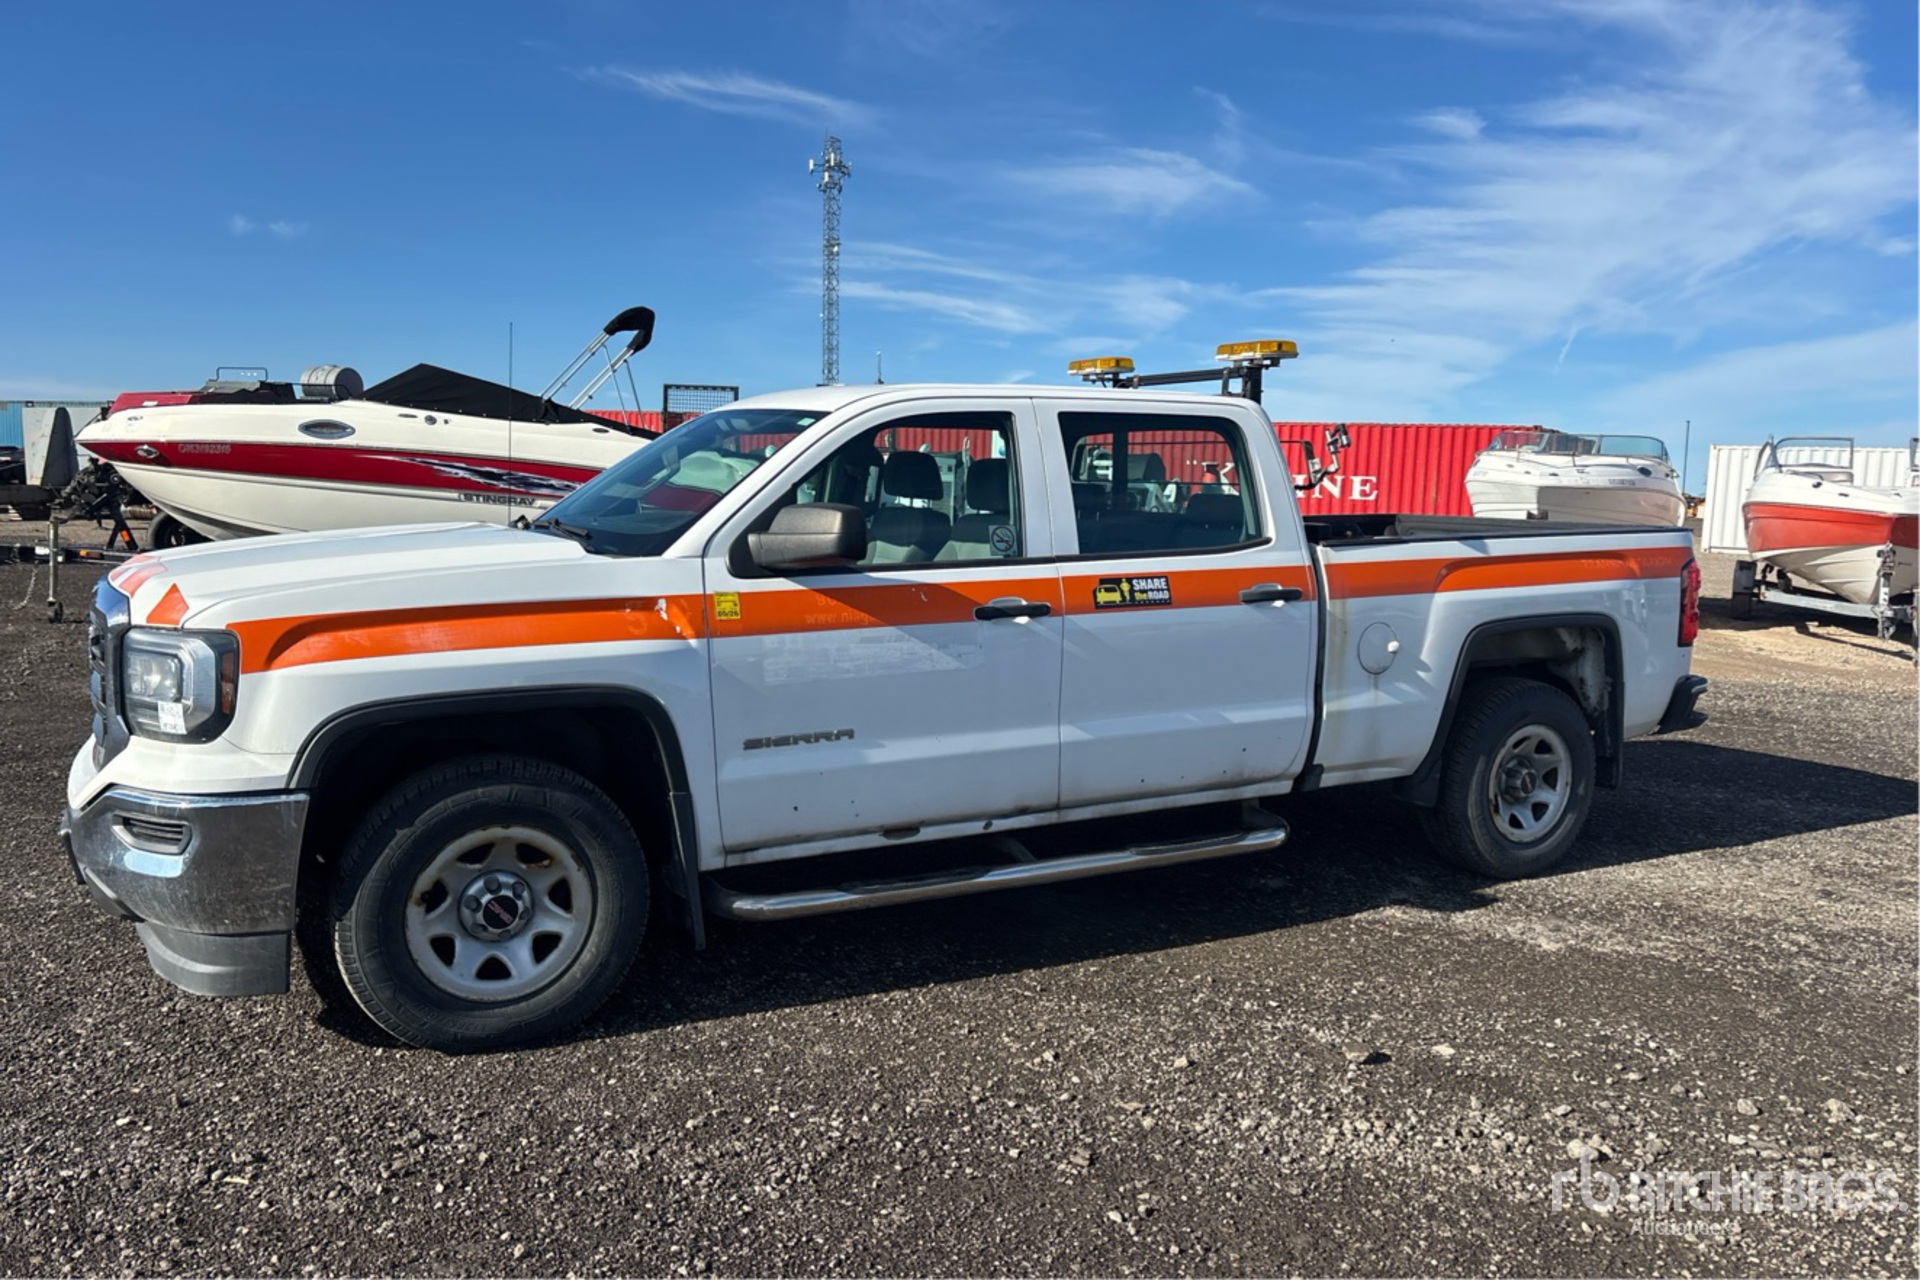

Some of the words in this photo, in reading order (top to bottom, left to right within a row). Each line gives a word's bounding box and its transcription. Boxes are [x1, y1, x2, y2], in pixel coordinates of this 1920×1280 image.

[1293, 474, 1378, 500] INE
[462, 492, 535, 506] STINGRAY
[1131, 577, 1168, 591] SHARE
[1134, 591, 1147, 600] the
[1148, 590, 1170, 600] ROAD
[743, 727, 855, 751] SIERRA
